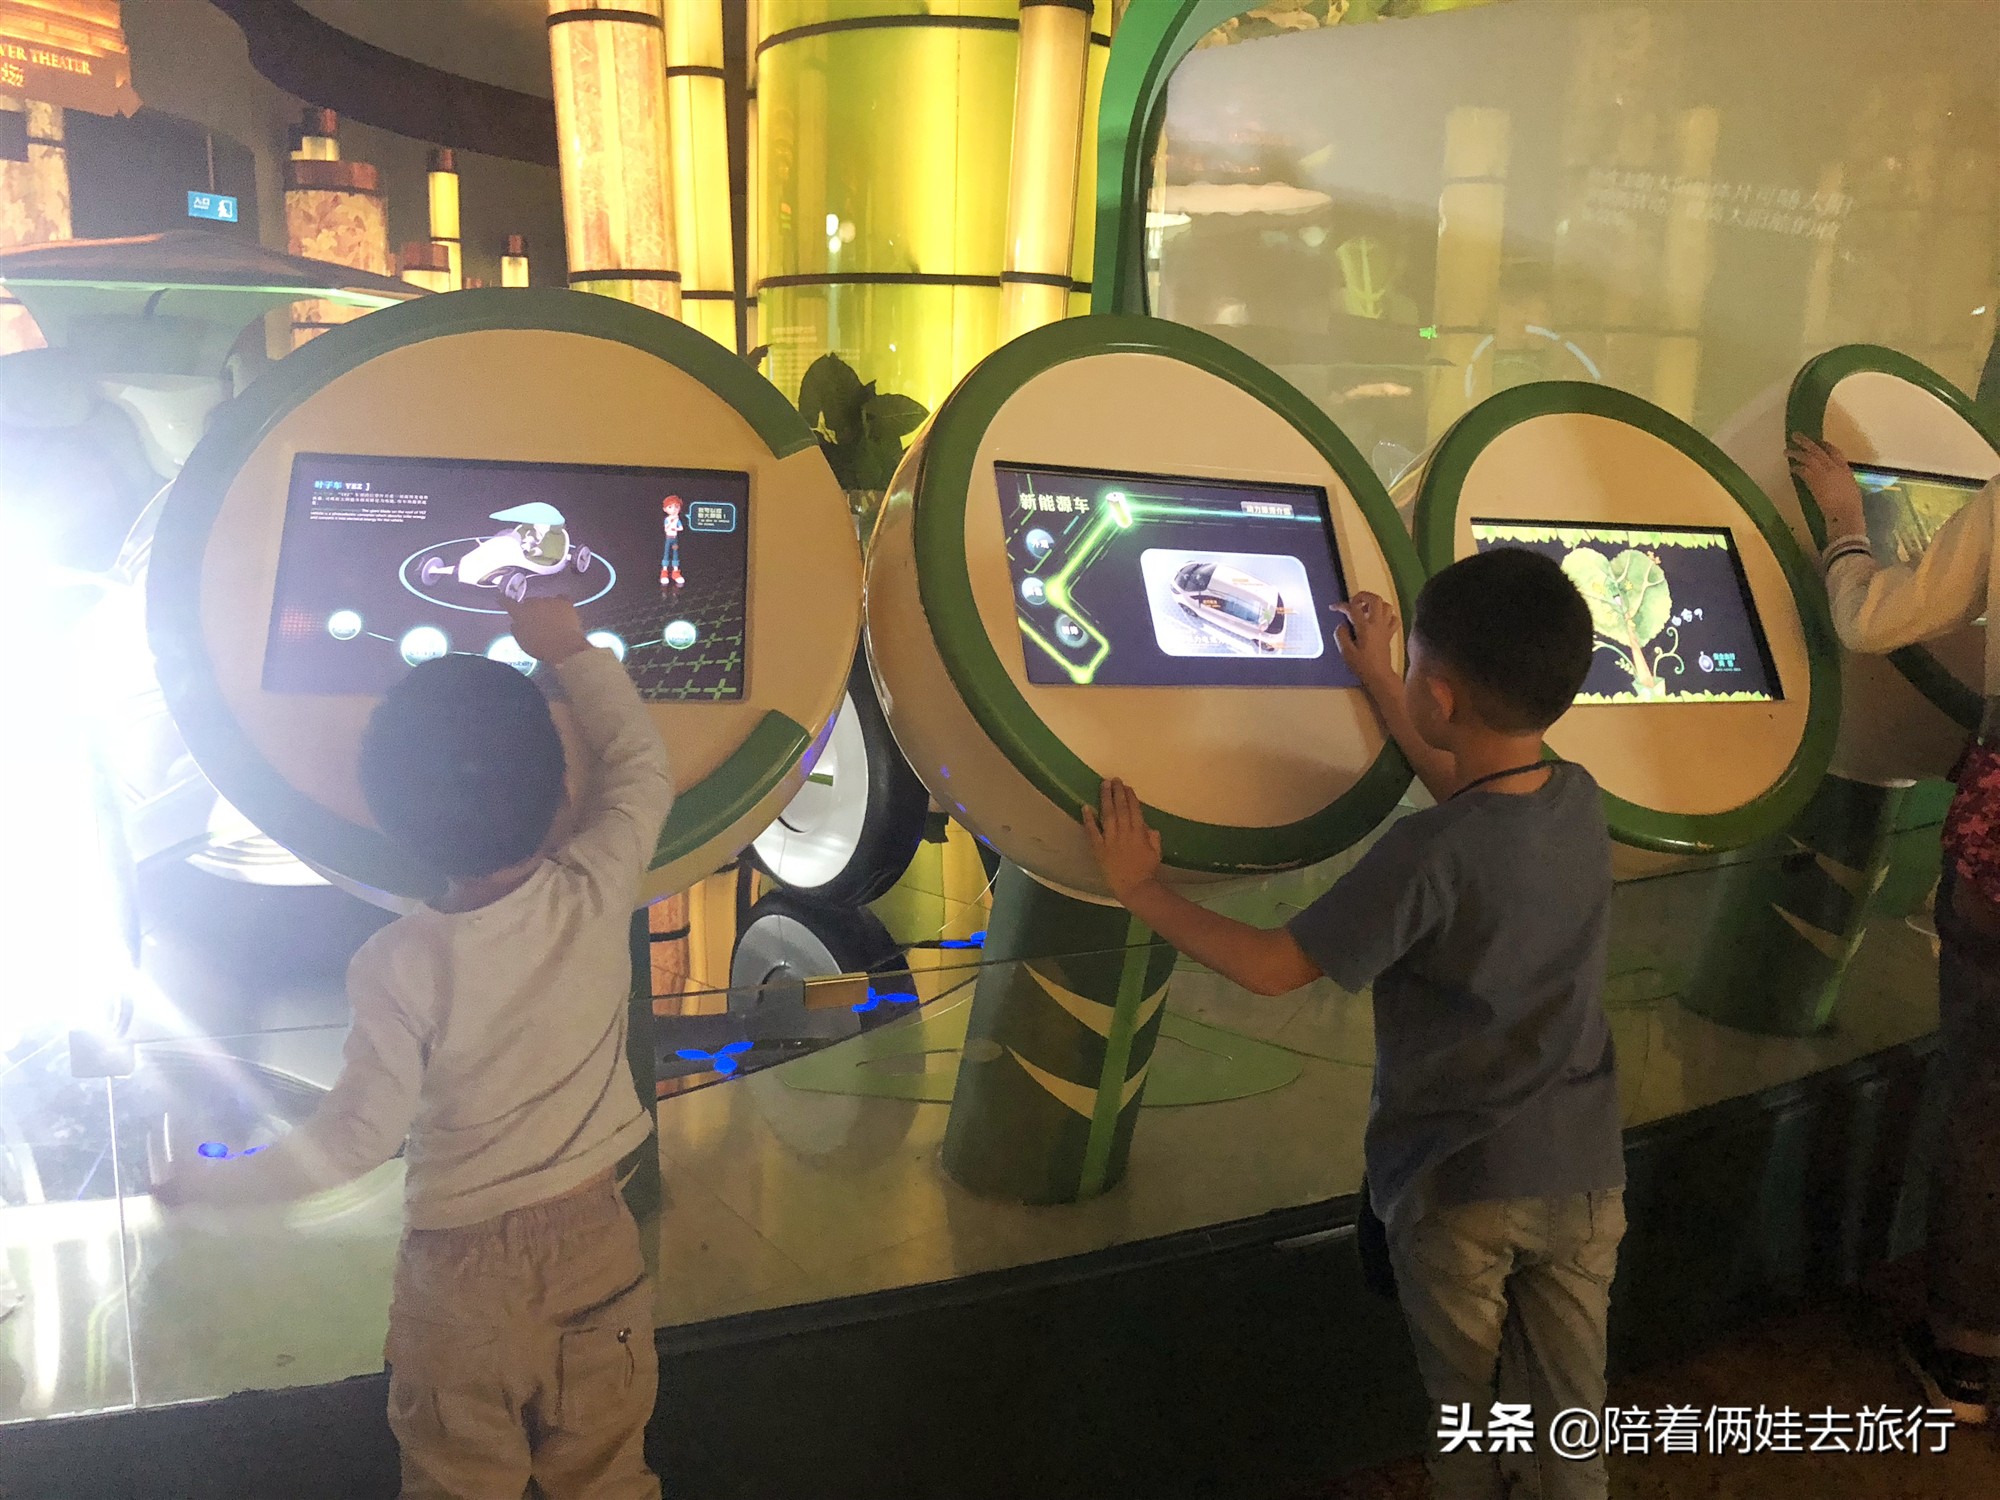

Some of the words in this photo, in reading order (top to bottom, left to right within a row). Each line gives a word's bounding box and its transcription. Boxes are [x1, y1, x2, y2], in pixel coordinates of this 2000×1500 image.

[30, 48, 92, 75] THEATER
[1019, 492, 1090, 514] 新能源车
